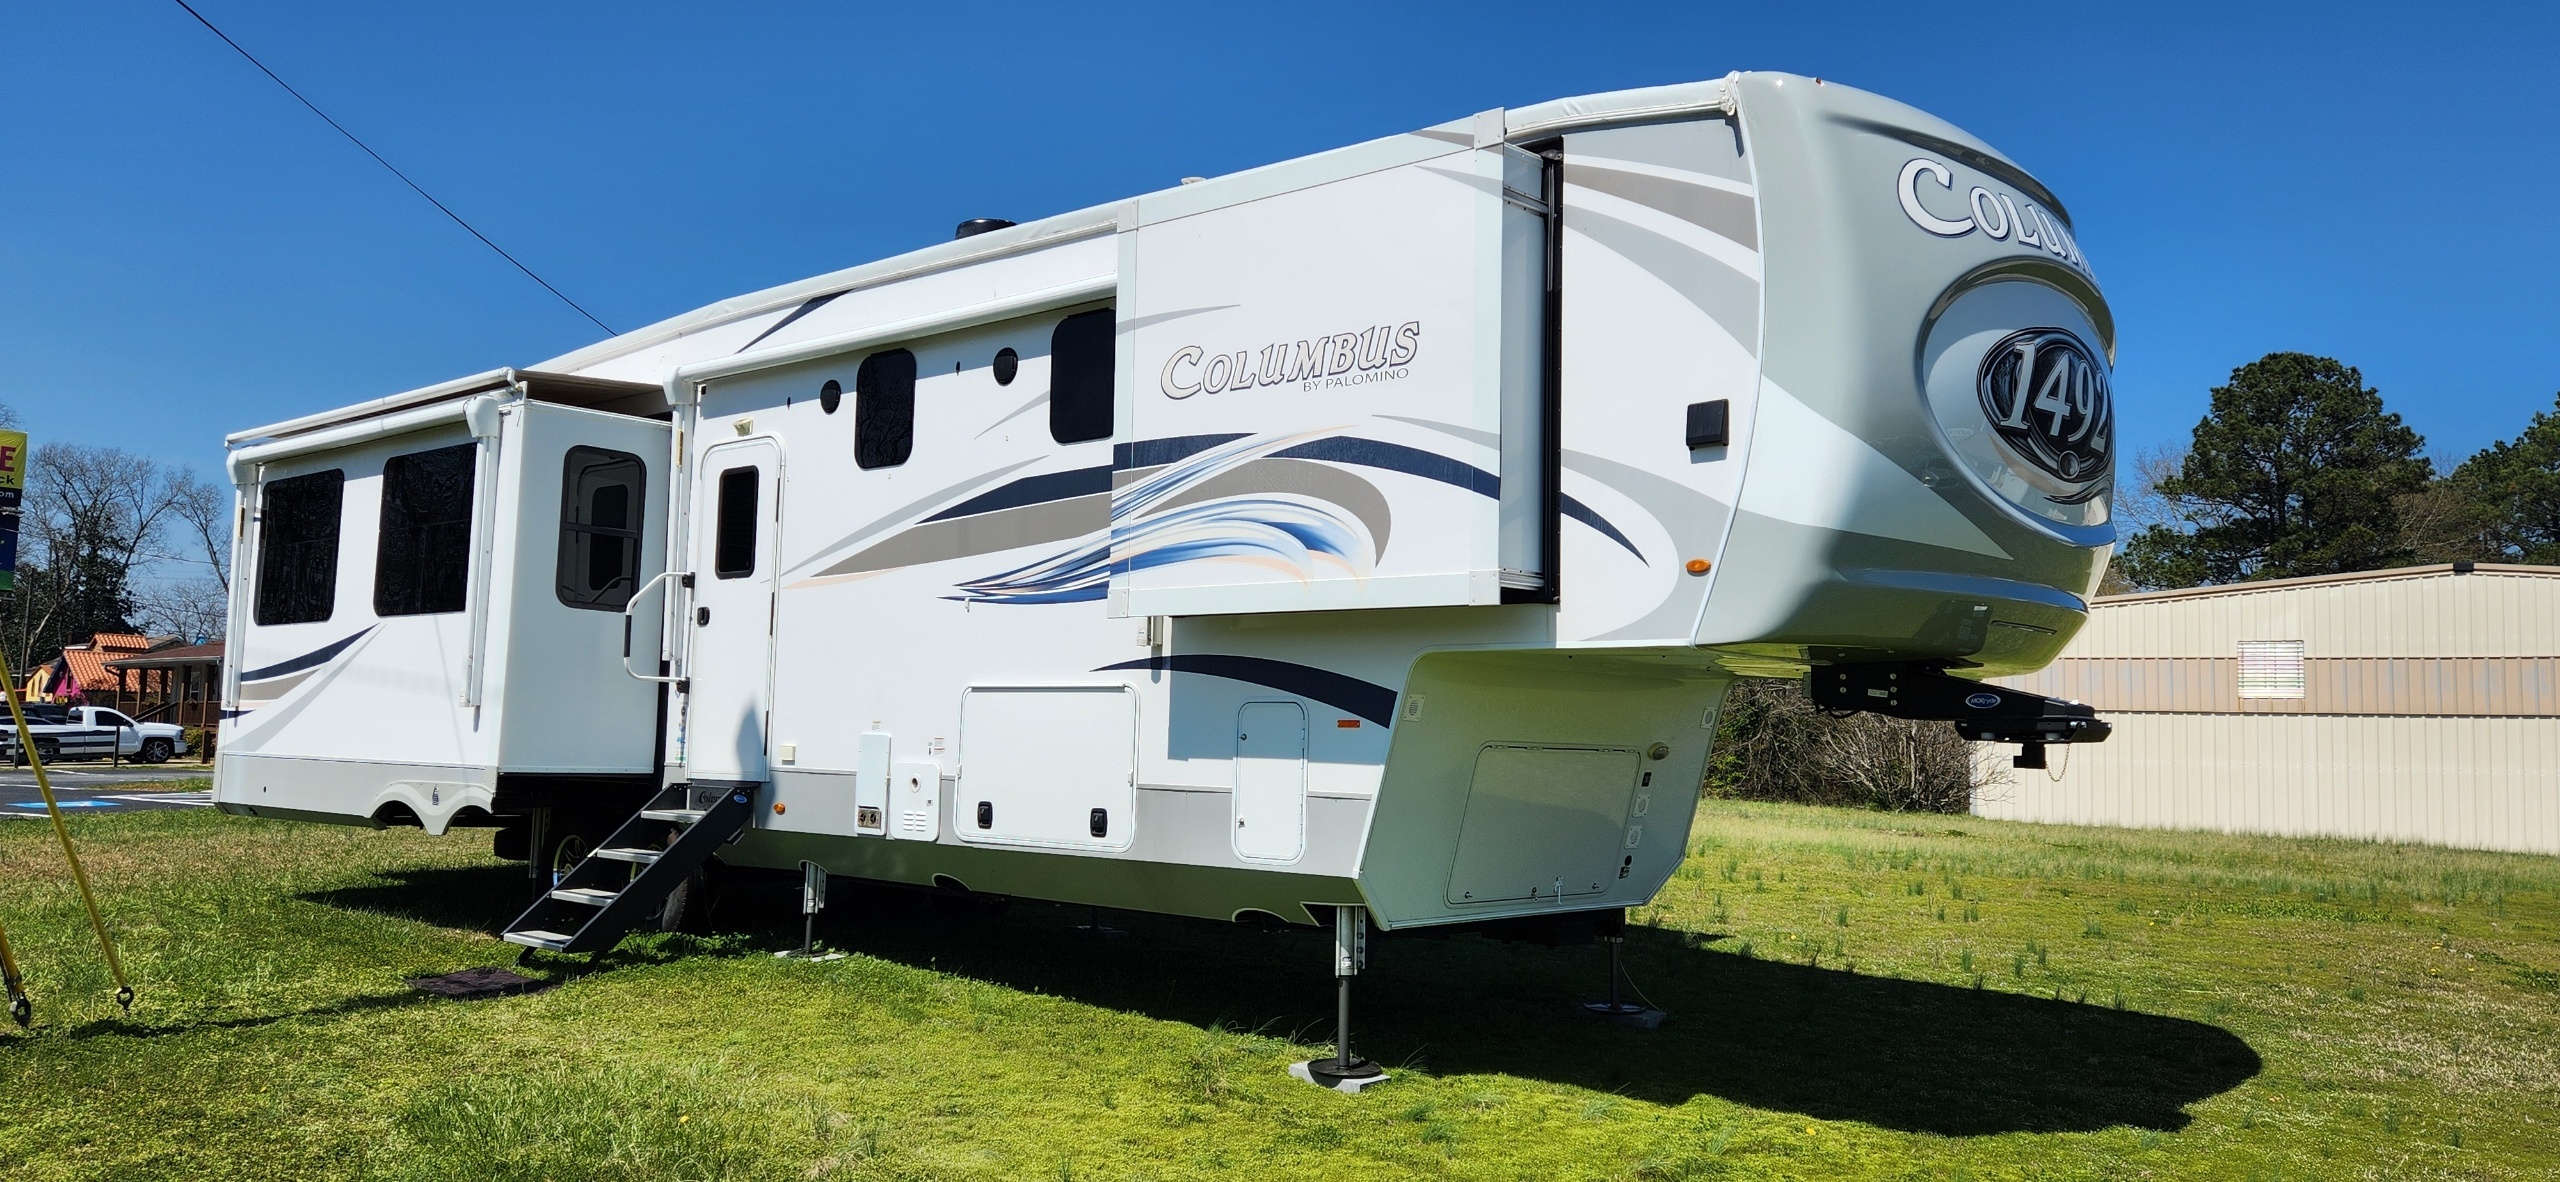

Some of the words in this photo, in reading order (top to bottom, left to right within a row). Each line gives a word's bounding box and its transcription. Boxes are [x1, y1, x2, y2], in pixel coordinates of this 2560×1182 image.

[1161, 321, 1420, 400] COLUMBUS
[1303, 380, 1321, 392] BY
[1326, 367, 1409, 389] PALOMINO
[2000, 341, 2109, 454] 1492
